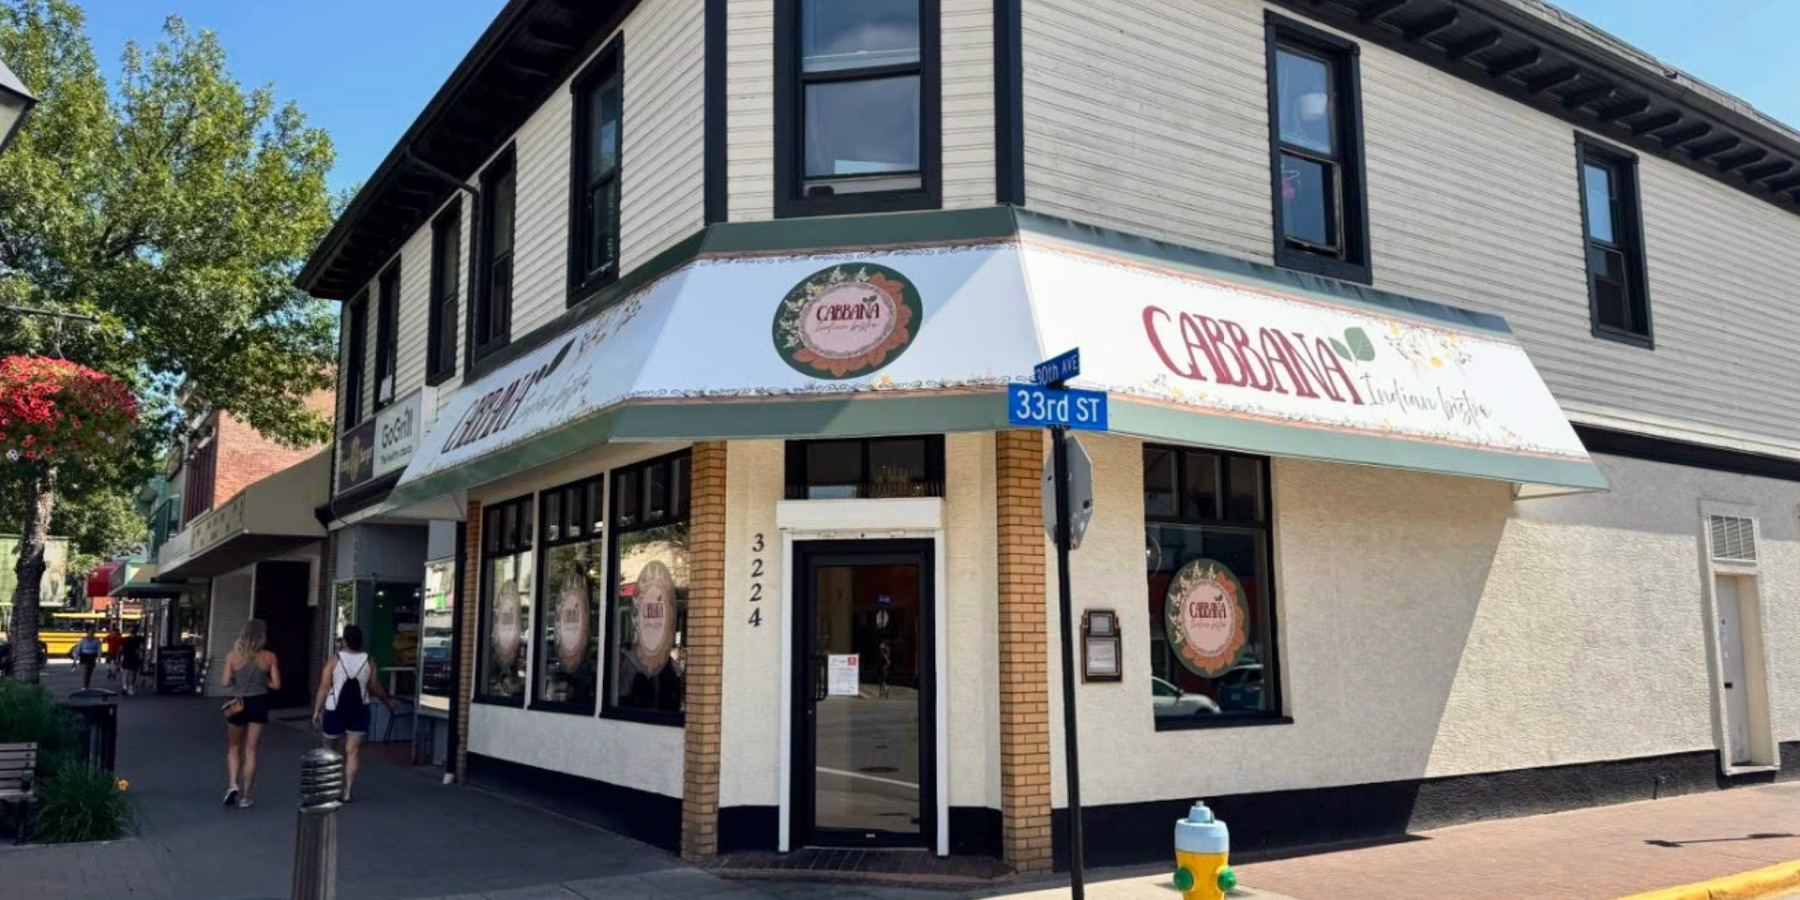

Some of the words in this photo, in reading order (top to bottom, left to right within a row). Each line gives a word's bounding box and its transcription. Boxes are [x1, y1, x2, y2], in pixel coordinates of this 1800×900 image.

[816, 302, 880, 321] CABBANA
[1036, 363, 1060, 386] 30th
[1061, 354, 1078, 375] AVE
[1142, 305, 1365, 405] CABBANA
[1016, 389, 1069, 422] 33rd
[1076, 397, 1100, 422] ST
[1359, 371, 1437, 415] Indian
[1436, 385, 1492, 430] bistro
[382, 406, 414, 449] GoGrill
[747, 532, 765, 627] 3224
